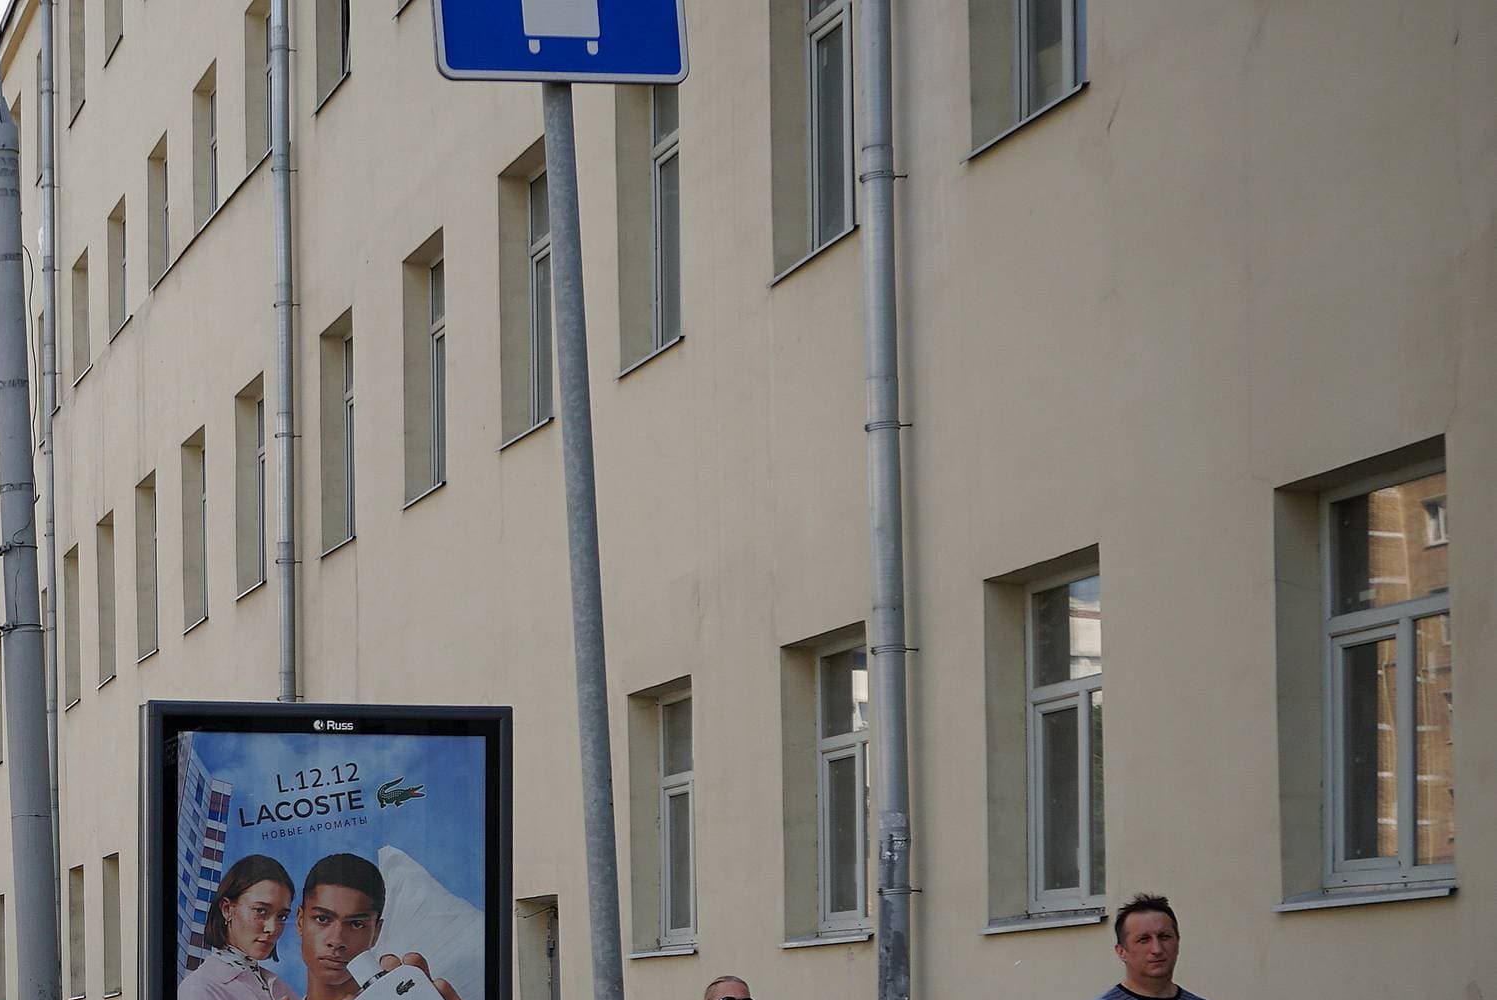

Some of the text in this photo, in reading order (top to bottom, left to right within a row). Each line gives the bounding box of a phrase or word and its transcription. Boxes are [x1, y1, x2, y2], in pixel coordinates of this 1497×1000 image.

[326, 719, 354, 731] Russ
[276, 763, 360, 793] L.12.12
[238, 790, 365, 828] LACOSTE
[261, 815, 368, 841] НОВЫЕ АРОМАТЫ
